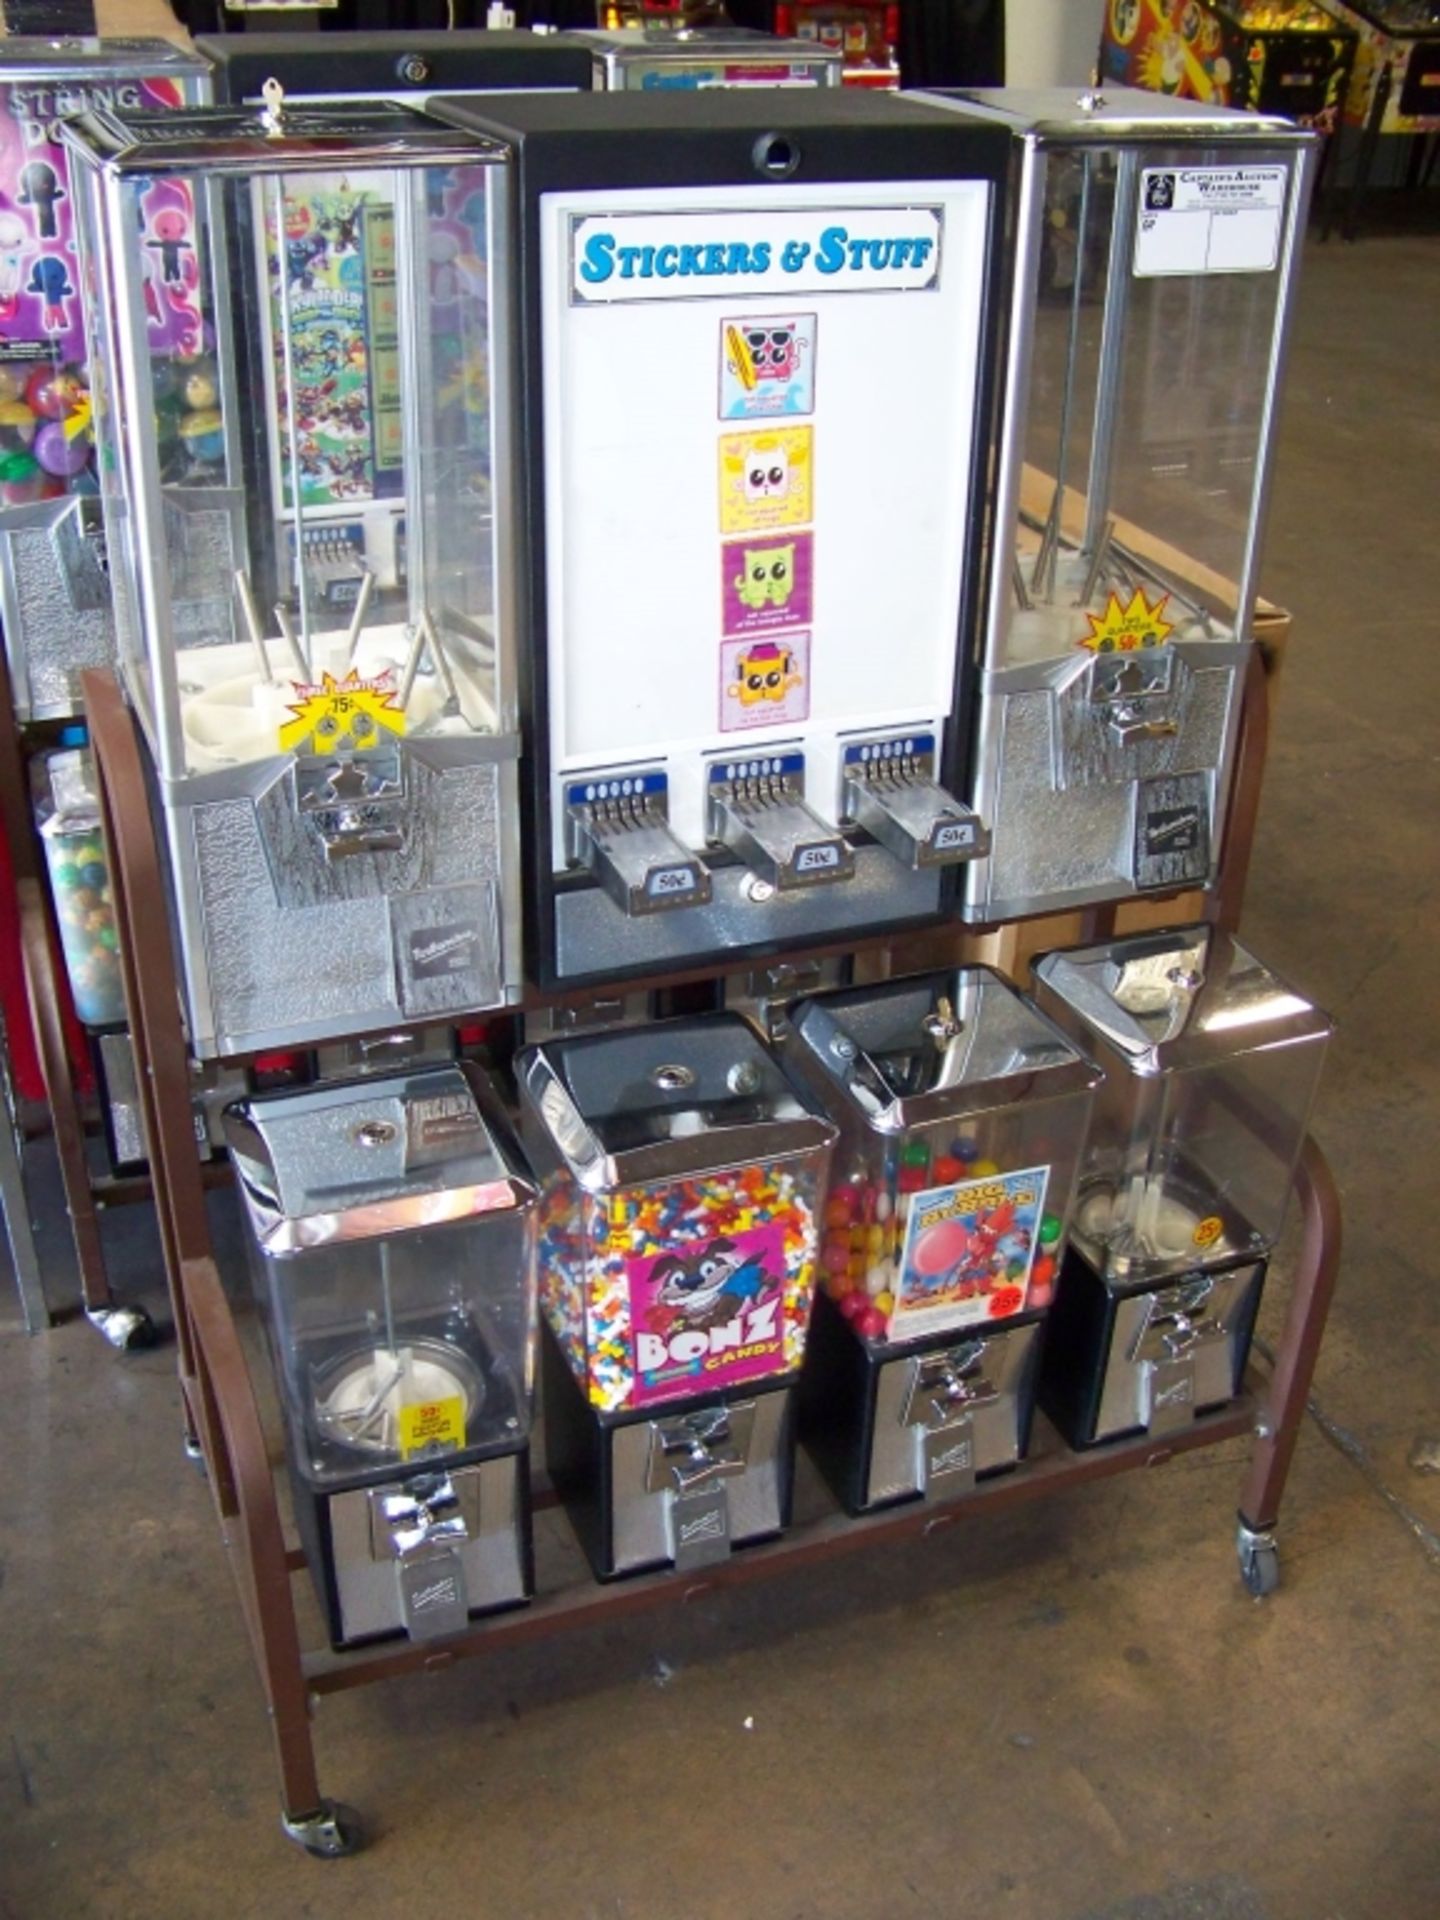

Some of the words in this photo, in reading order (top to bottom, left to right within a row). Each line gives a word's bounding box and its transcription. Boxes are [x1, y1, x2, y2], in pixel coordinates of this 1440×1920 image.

[9, 85, 142, 117] STRING
[580, 233, 772, 284] STICKERS
[780, 240, 811, 273] &
[814, 226, 933, 275] STUFF
[942, 828, 968, 842] 50¢
[804, 850, 832, 865] 50¢
[636, 1297, 781, 1374] BONZ
[704, 1341, 782, 1371] CANDY
